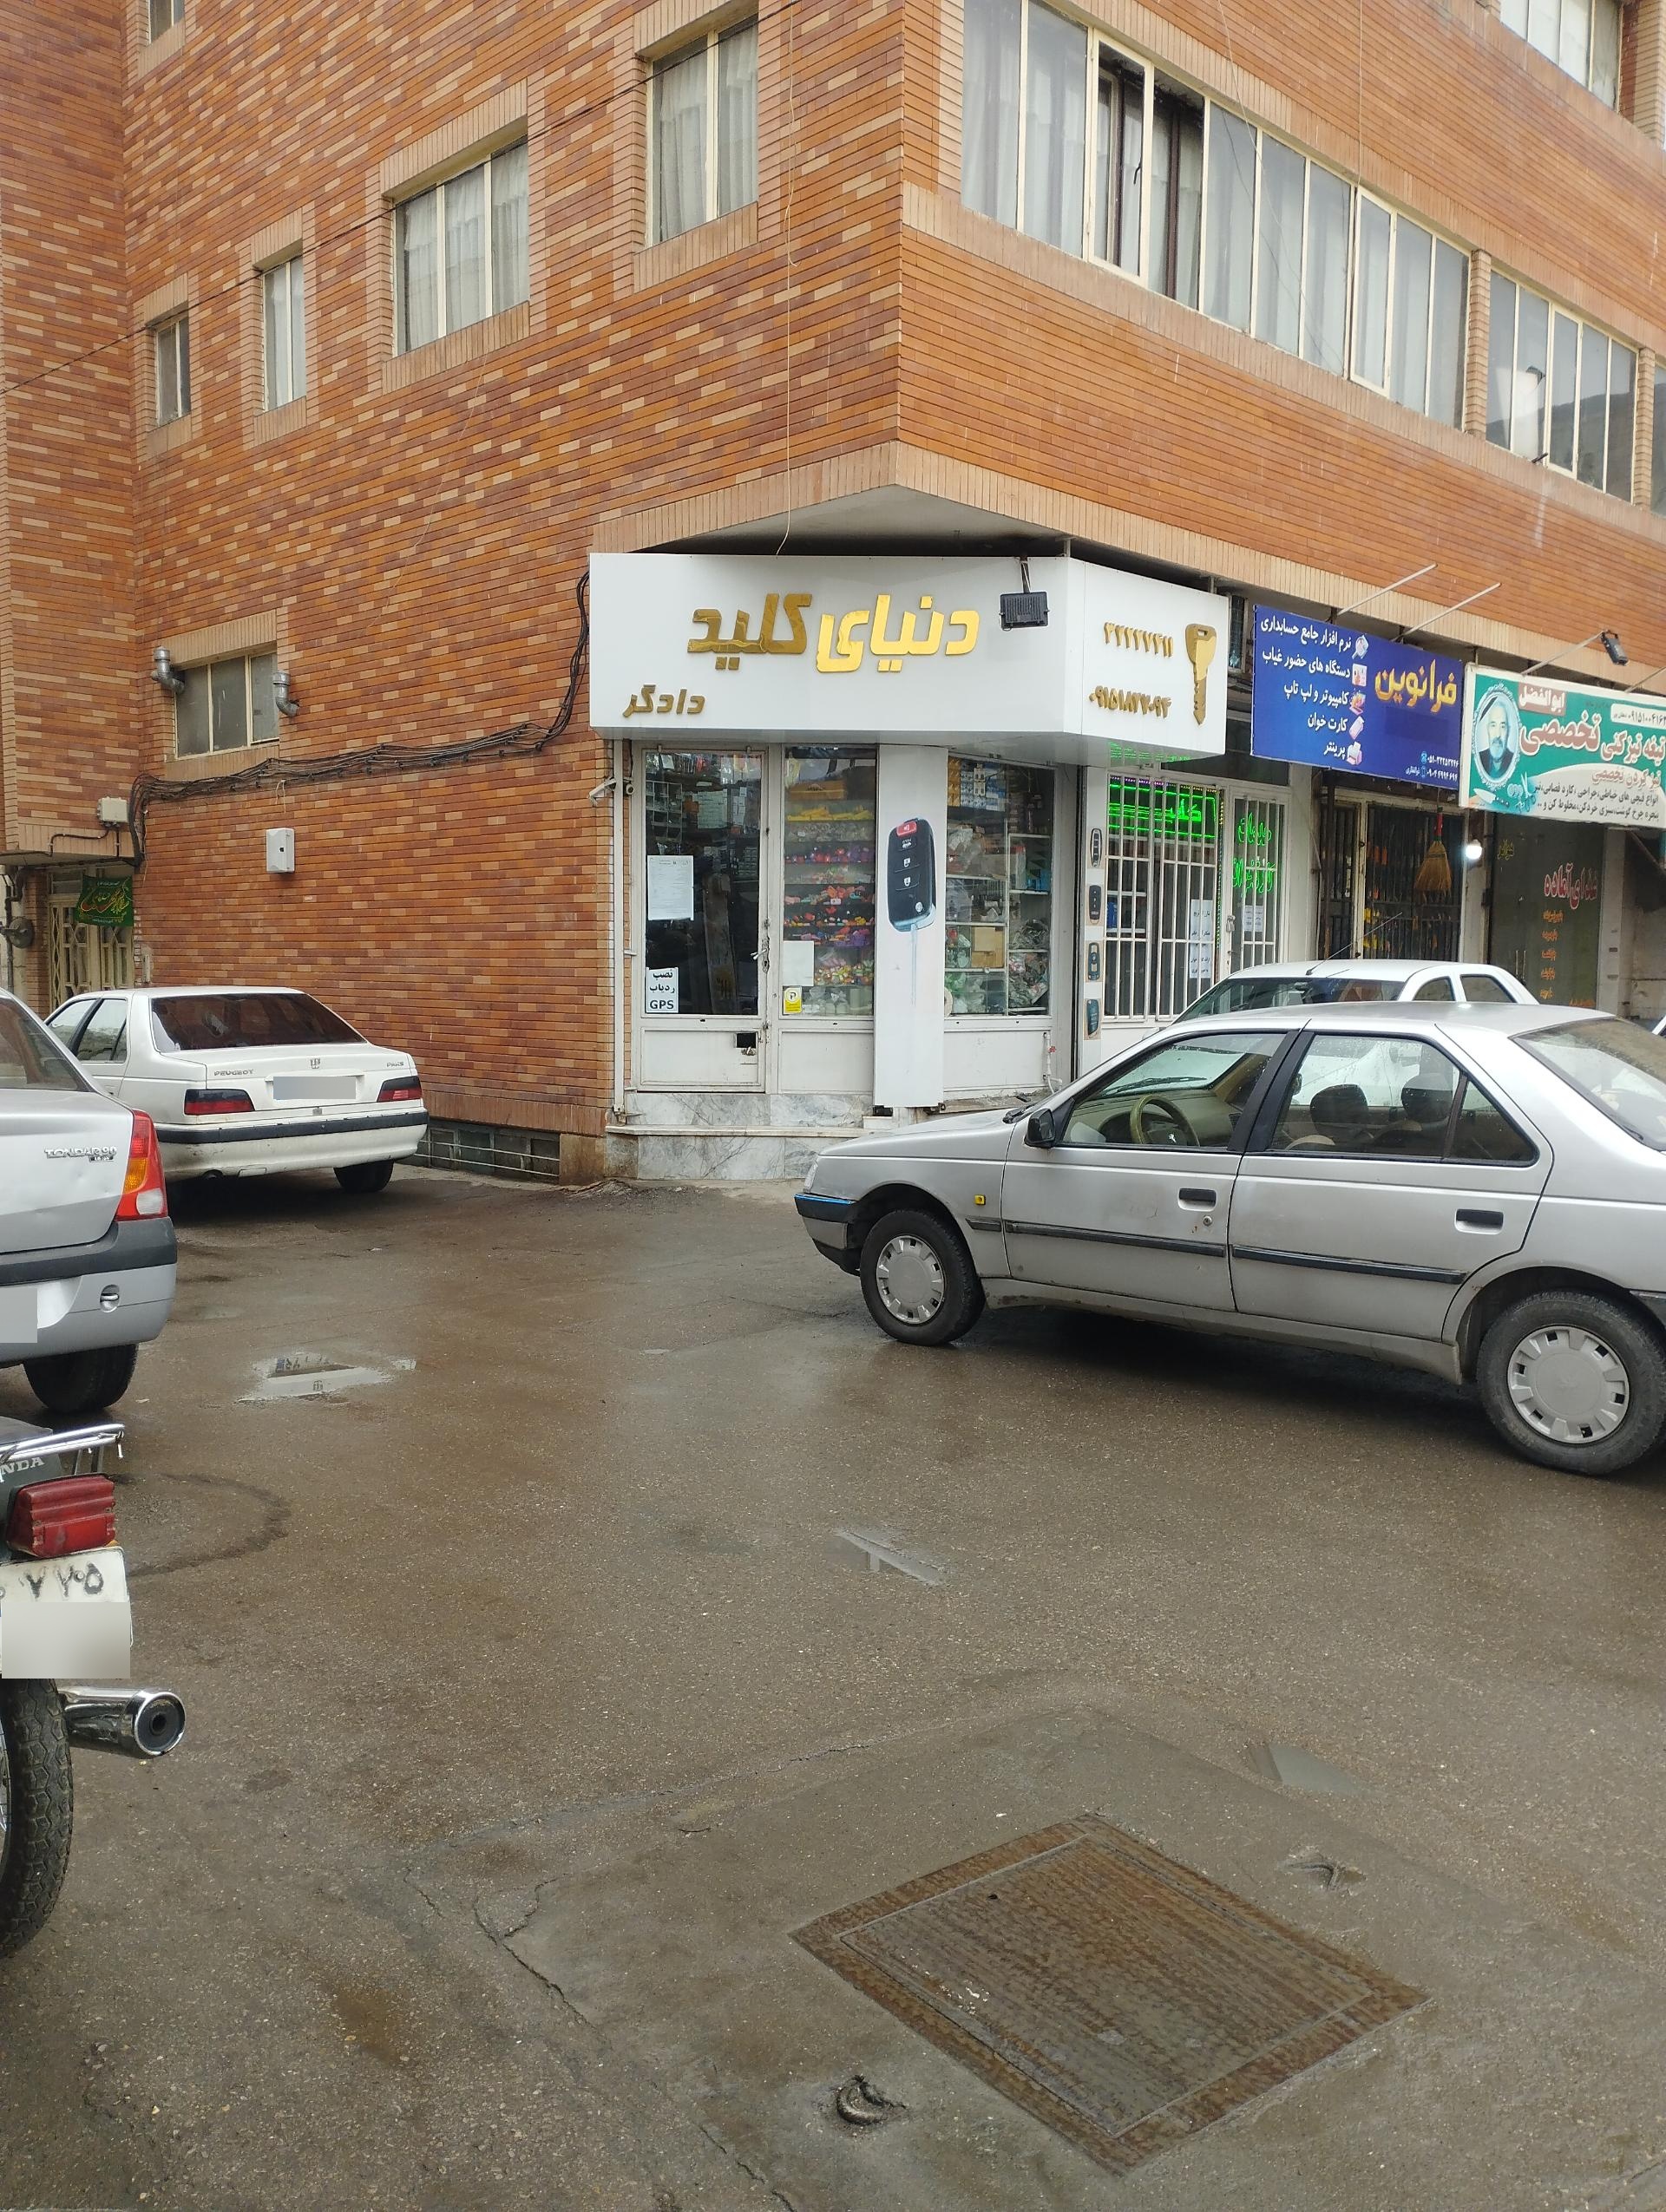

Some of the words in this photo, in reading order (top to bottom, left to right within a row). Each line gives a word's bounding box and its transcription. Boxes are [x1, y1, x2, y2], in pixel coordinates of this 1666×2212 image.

[687, 592, 812, 670] کلید
[816, 594, 979, 672] دنیای
[1261, 615, 1300, 635] حسابداری
[1301, 625, 1319, 645] جامع
[1321, 629, 1338, 648] افزار
[1339, 637, 1352, 653] نرم
[1262, 646, 1282, 666] غیاب
[1284, 652, 1307, 669] حضور
[1309, 657, 1323, 673] های
[1325, 659, 1350, 678] دستگاه
[622, 684, 705, 718] دادگر
[1320, 690, 1349, 710] کامپیوتر
[1519, 685, 1565, 713] ابوالفضل
[1308, 713, 1327, 731] خوان
[1328, 717, 1348, 731] کارت
[1519, 710, 1602, 756] تخصصی
[1323, 741, 1347, 760] پرینتر
[653, 967, 673, 980] نصب
[649, 982, 675, 995] ردیاب
[649, 999, 674, 1011] GPS
[213, 1068, 253, 1077] PEUGEOT
